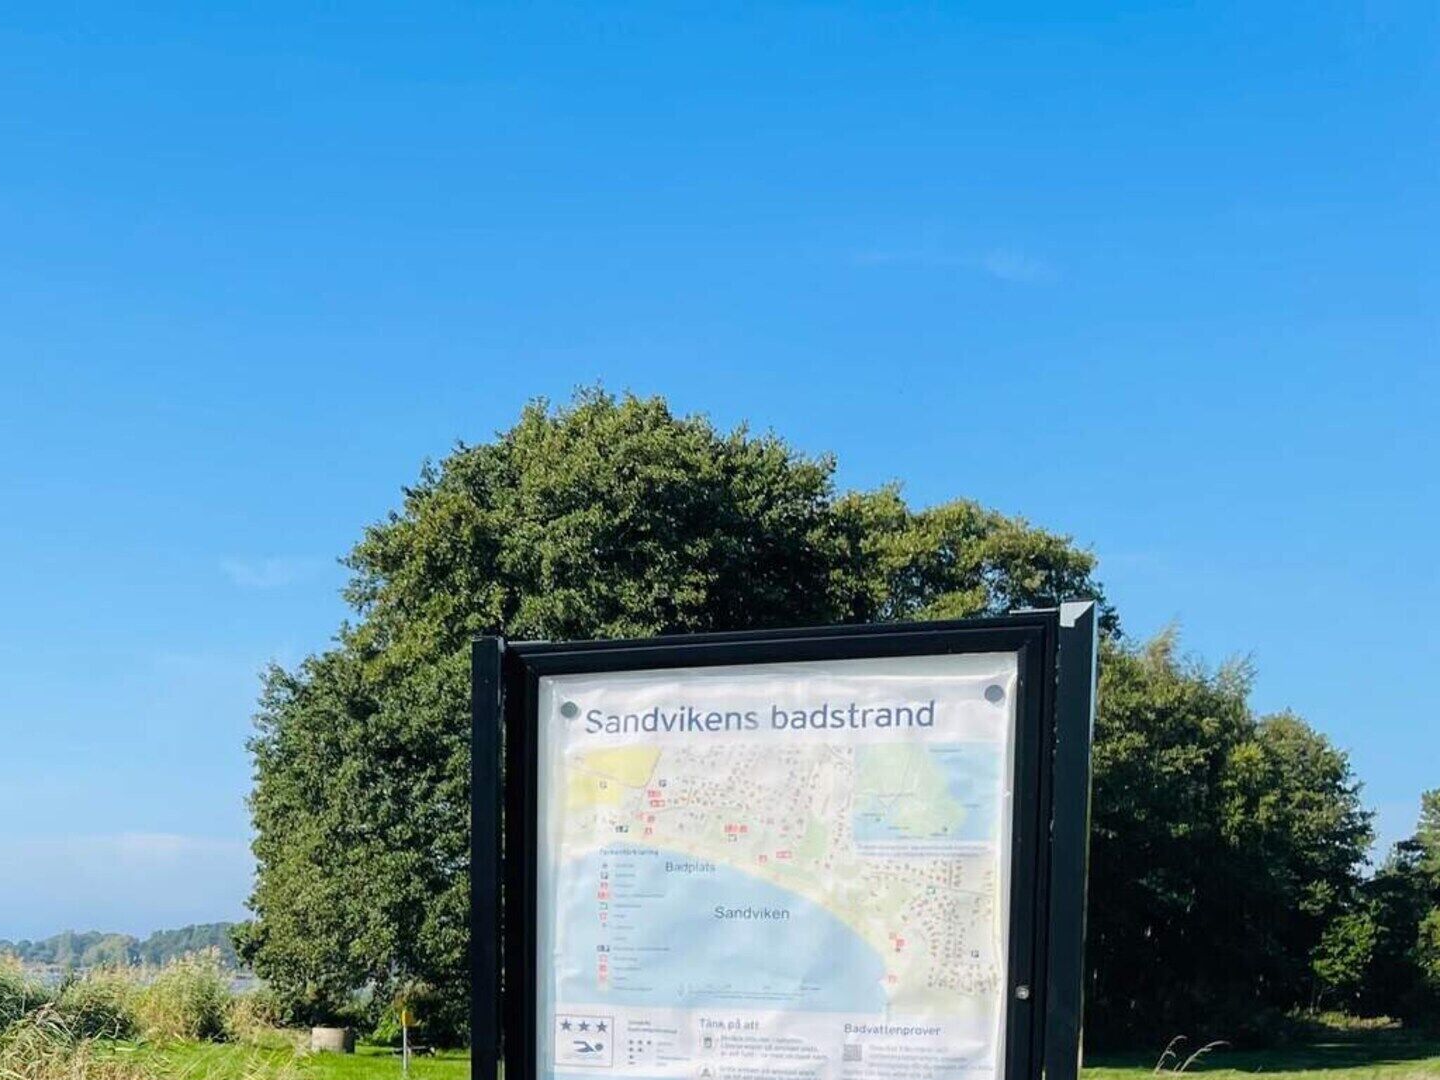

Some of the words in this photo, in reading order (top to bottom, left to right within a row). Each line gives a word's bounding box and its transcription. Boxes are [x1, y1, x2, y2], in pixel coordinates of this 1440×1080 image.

[585, 704, 759, 733] Sandvikens
[772, 700, 935, 730] badstrand
[665, 861, 716, 873] Badplats
[714, 906, 790, 919] Sandviken
[844, 1023, 941, 1036] Badvattenprover
